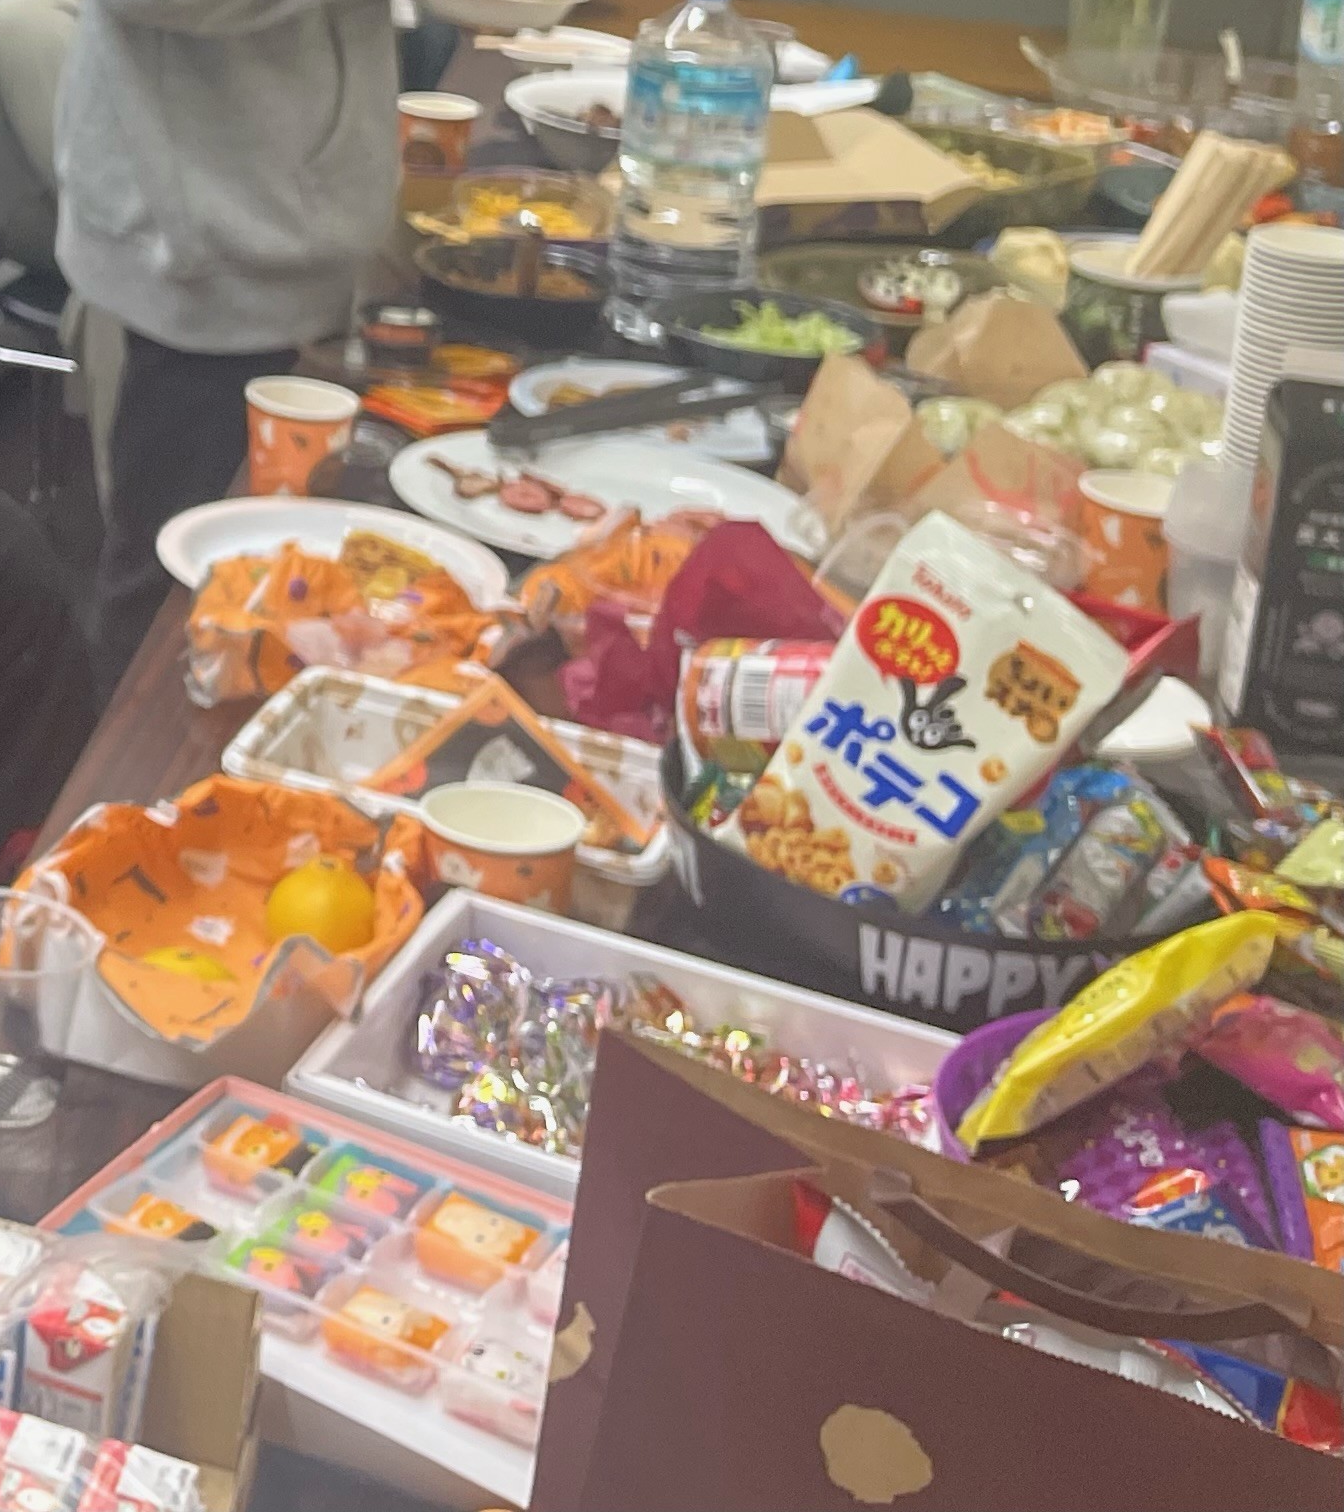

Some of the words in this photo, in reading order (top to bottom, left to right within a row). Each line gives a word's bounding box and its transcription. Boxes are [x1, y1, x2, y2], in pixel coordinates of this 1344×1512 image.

[805, 698, 980, 838] ポテコ
[859, 923, 1089, 1018] HAPPY
